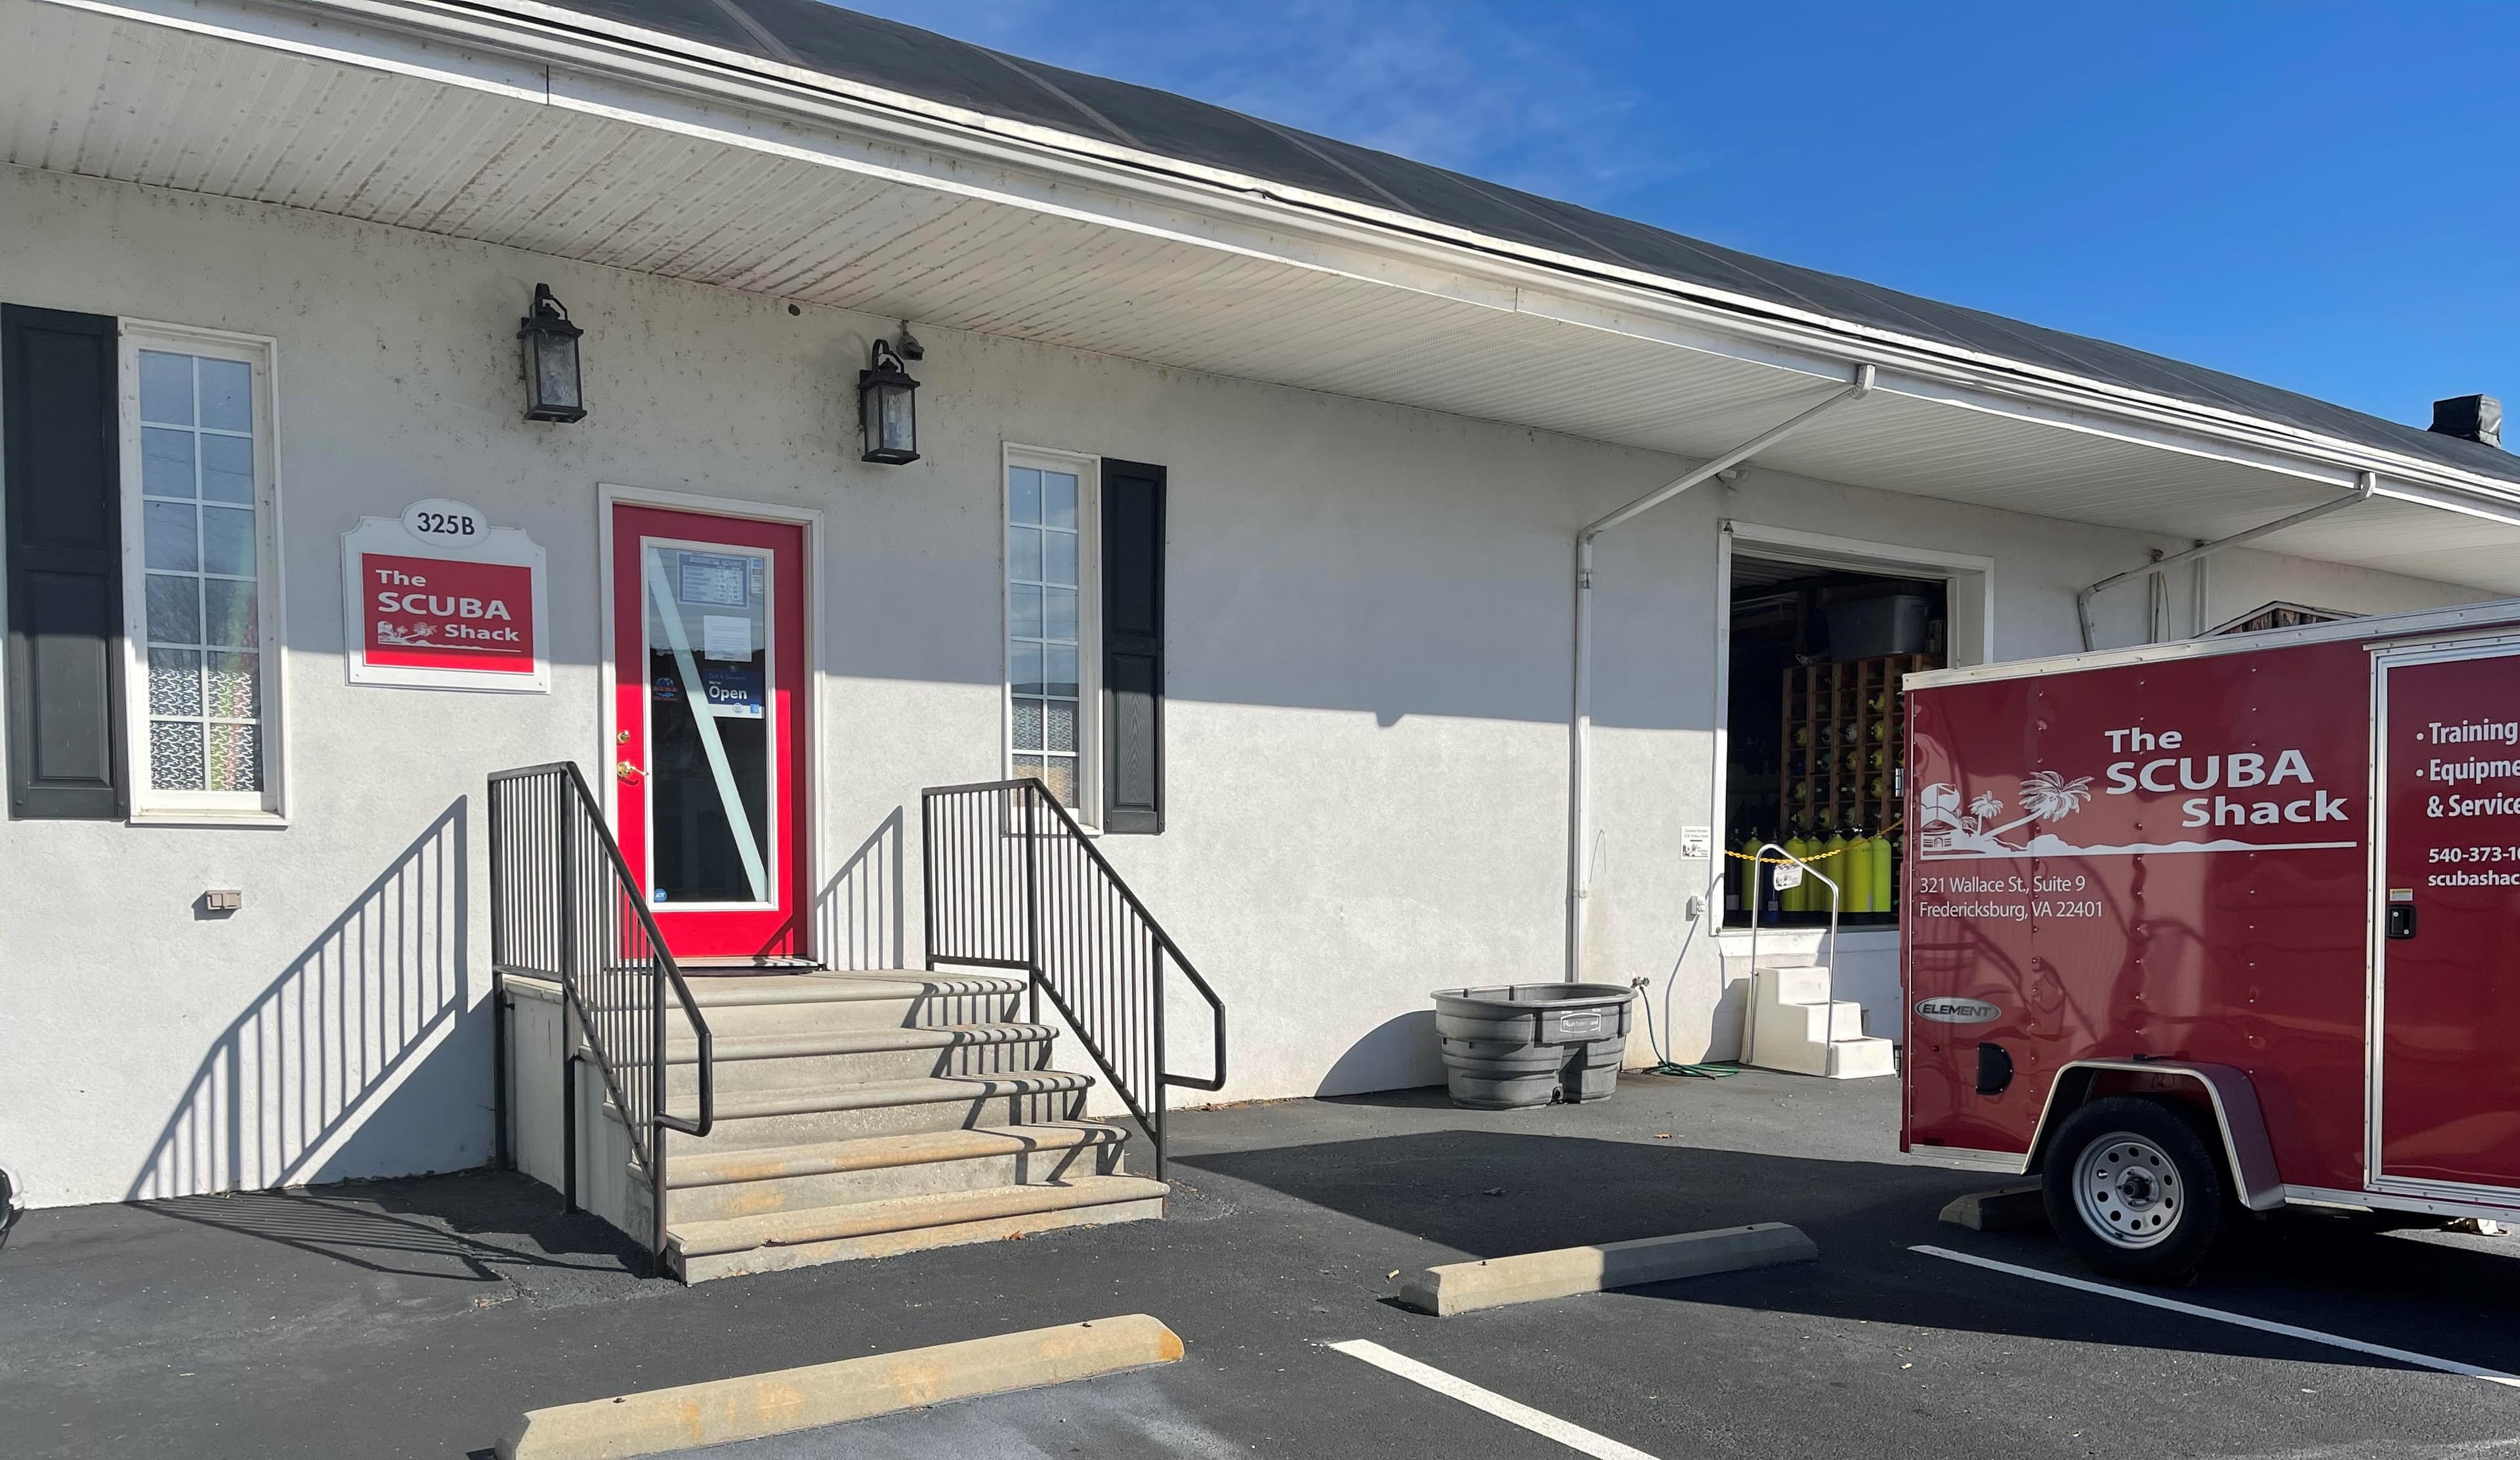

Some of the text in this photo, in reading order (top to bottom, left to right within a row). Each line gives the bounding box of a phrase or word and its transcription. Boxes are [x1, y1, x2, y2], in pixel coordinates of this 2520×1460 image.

[417, 512, 475, 535] 325B
[375, 569, 426, 587] The
[378, 591, 511, 620] SCUBA
[444, 624, 520, 642] Shack
[709, 685, 747, 702] Open
[2104, 727, 2183, 754] The
[2429, 718, 2519, 745] Training
[2105, 749, 2315, 795] SCUBA
[2181, 790, 2350, 828] Shack
[2427, 795, 2444, 818] &
[2428, 846, 2520, 863] 540-373-1
[1920, 877, 1944, 893] 321
[1949, 876, 2004, 893] Wallace
[2034, 875, 2072, 892] Suite
[2076, 875, 2086, 891] 9
[2428, 869, 2520, 886] scubashac
[1920, 900, 2103, 922] Fredericksburg, VA 22401
[1922, 1004, 1992, 1017] ELEMENT
